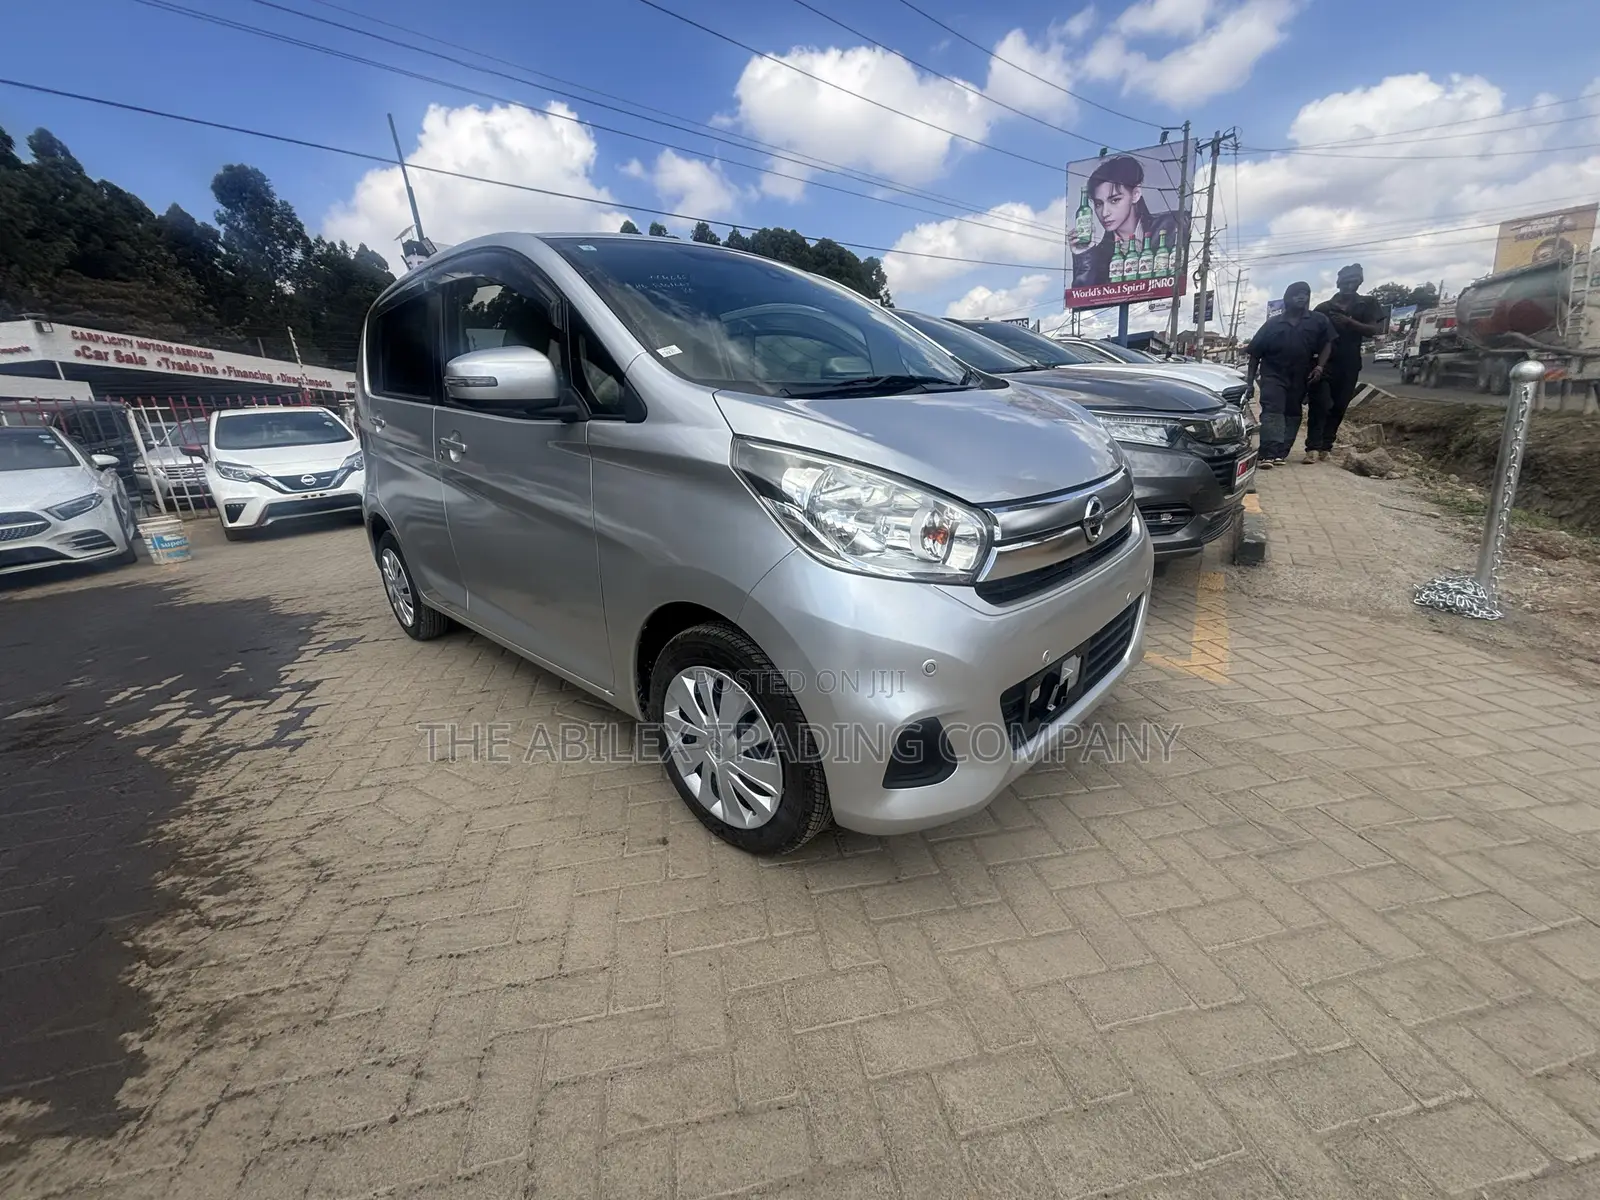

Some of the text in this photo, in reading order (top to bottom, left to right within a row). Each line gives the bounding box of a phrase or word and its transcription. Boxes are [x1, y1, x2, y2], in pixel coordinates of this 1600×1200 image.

[1072, 277, 1175, 298] World's No.1 Spirit JINRO
[136, 340, 174, 355] MOTORS
[175, 347, 215, 360] SERVICES
[80, 345, 109, 361] Car
[114, 349, 147, 366] Sale
[160, 357, 199, 373] Trade
[200, 362, 219, 375] ins
[226, 365, 274, 383] Financing
